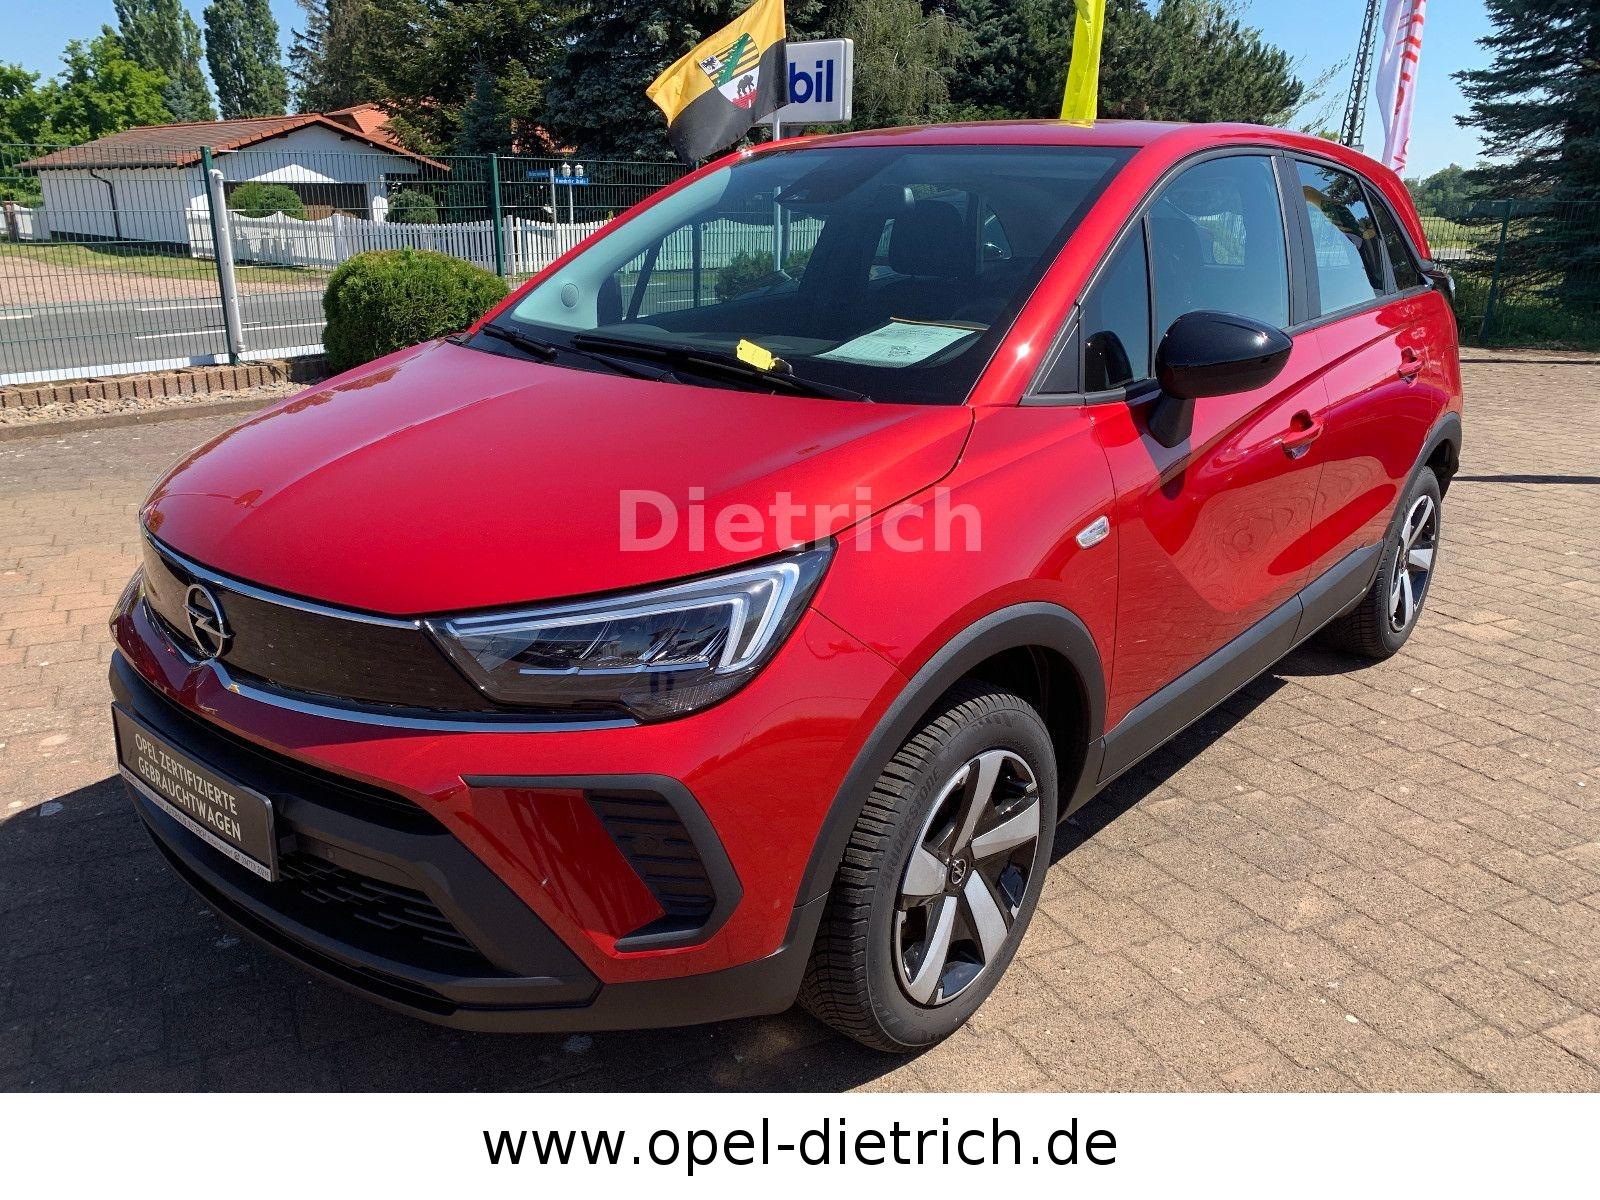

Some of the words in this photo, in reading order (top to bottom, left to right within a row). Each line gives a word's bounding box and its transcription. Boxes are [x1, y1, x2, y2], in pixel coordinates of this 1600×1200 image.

[789, 59, 834, 104] bil
[134, 733, 158, 760] OPEL
[159, 750, 239, 816] ZERTIFIZIERTE
[138, 756, 242, 842] GEBRAUCHTWAGEN
